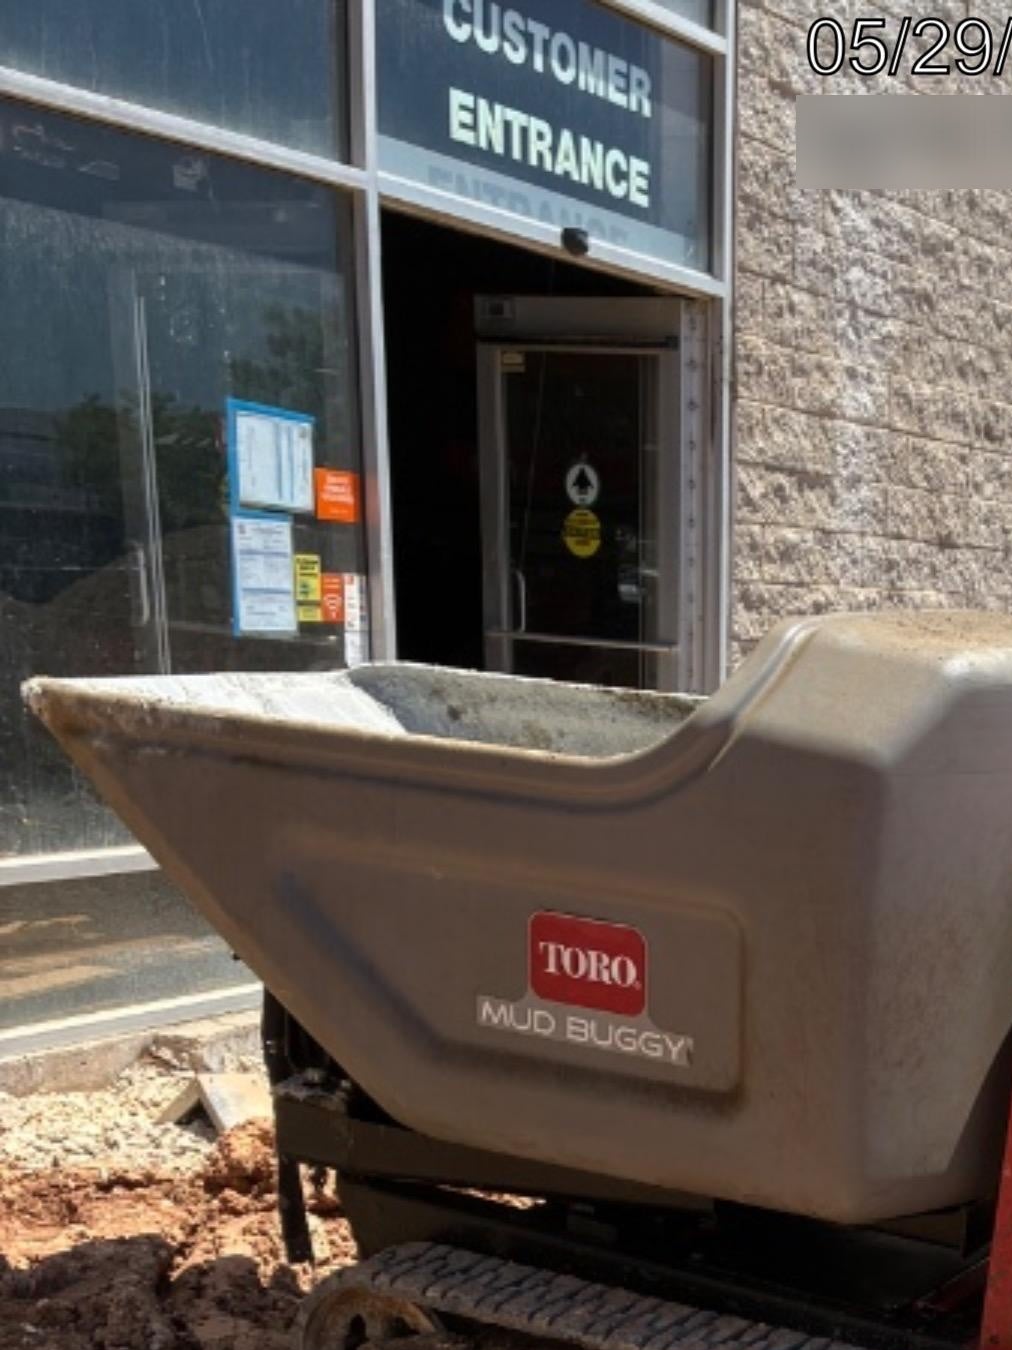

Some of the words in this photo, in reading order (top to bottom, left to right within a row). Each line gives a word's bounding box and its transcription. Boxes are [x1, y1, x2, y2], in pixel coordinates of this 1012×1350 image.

[443, 0, 652, 118] CUSTOMER
[449, 86, 650, 208] ENTRANCE
[480, 1000, 556, 1036] MUD
[566, 1016, 687, 1062] BUGGY
